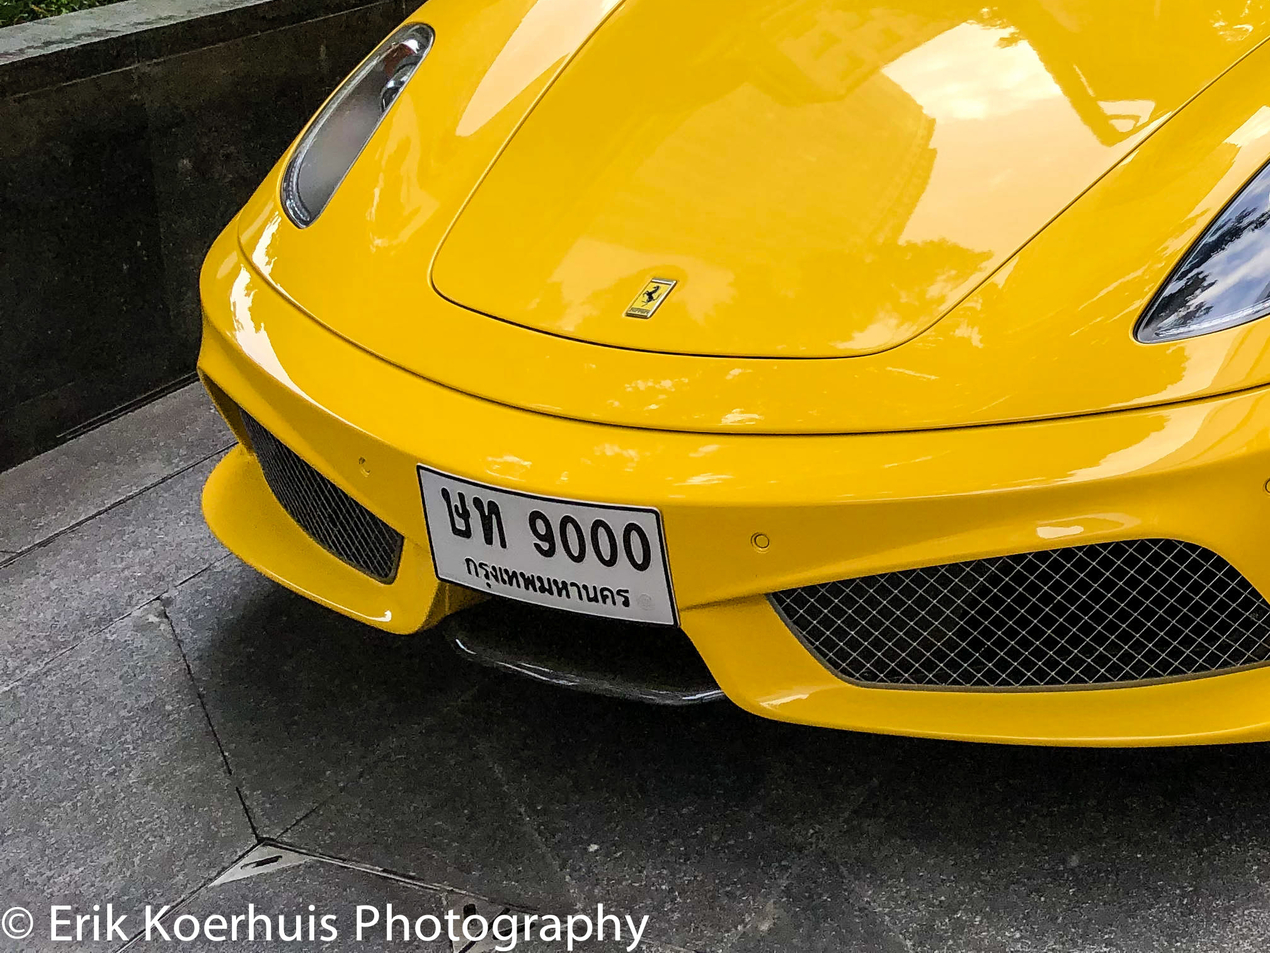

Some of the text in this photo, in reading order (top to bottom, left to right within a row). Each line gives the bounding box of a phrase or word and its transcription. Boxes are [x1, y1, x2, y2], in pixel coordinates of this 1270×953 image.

[440, 487, 651, 571] ษท 9000
[464, 557, 631, 608] กรุงเทพมหานคร
